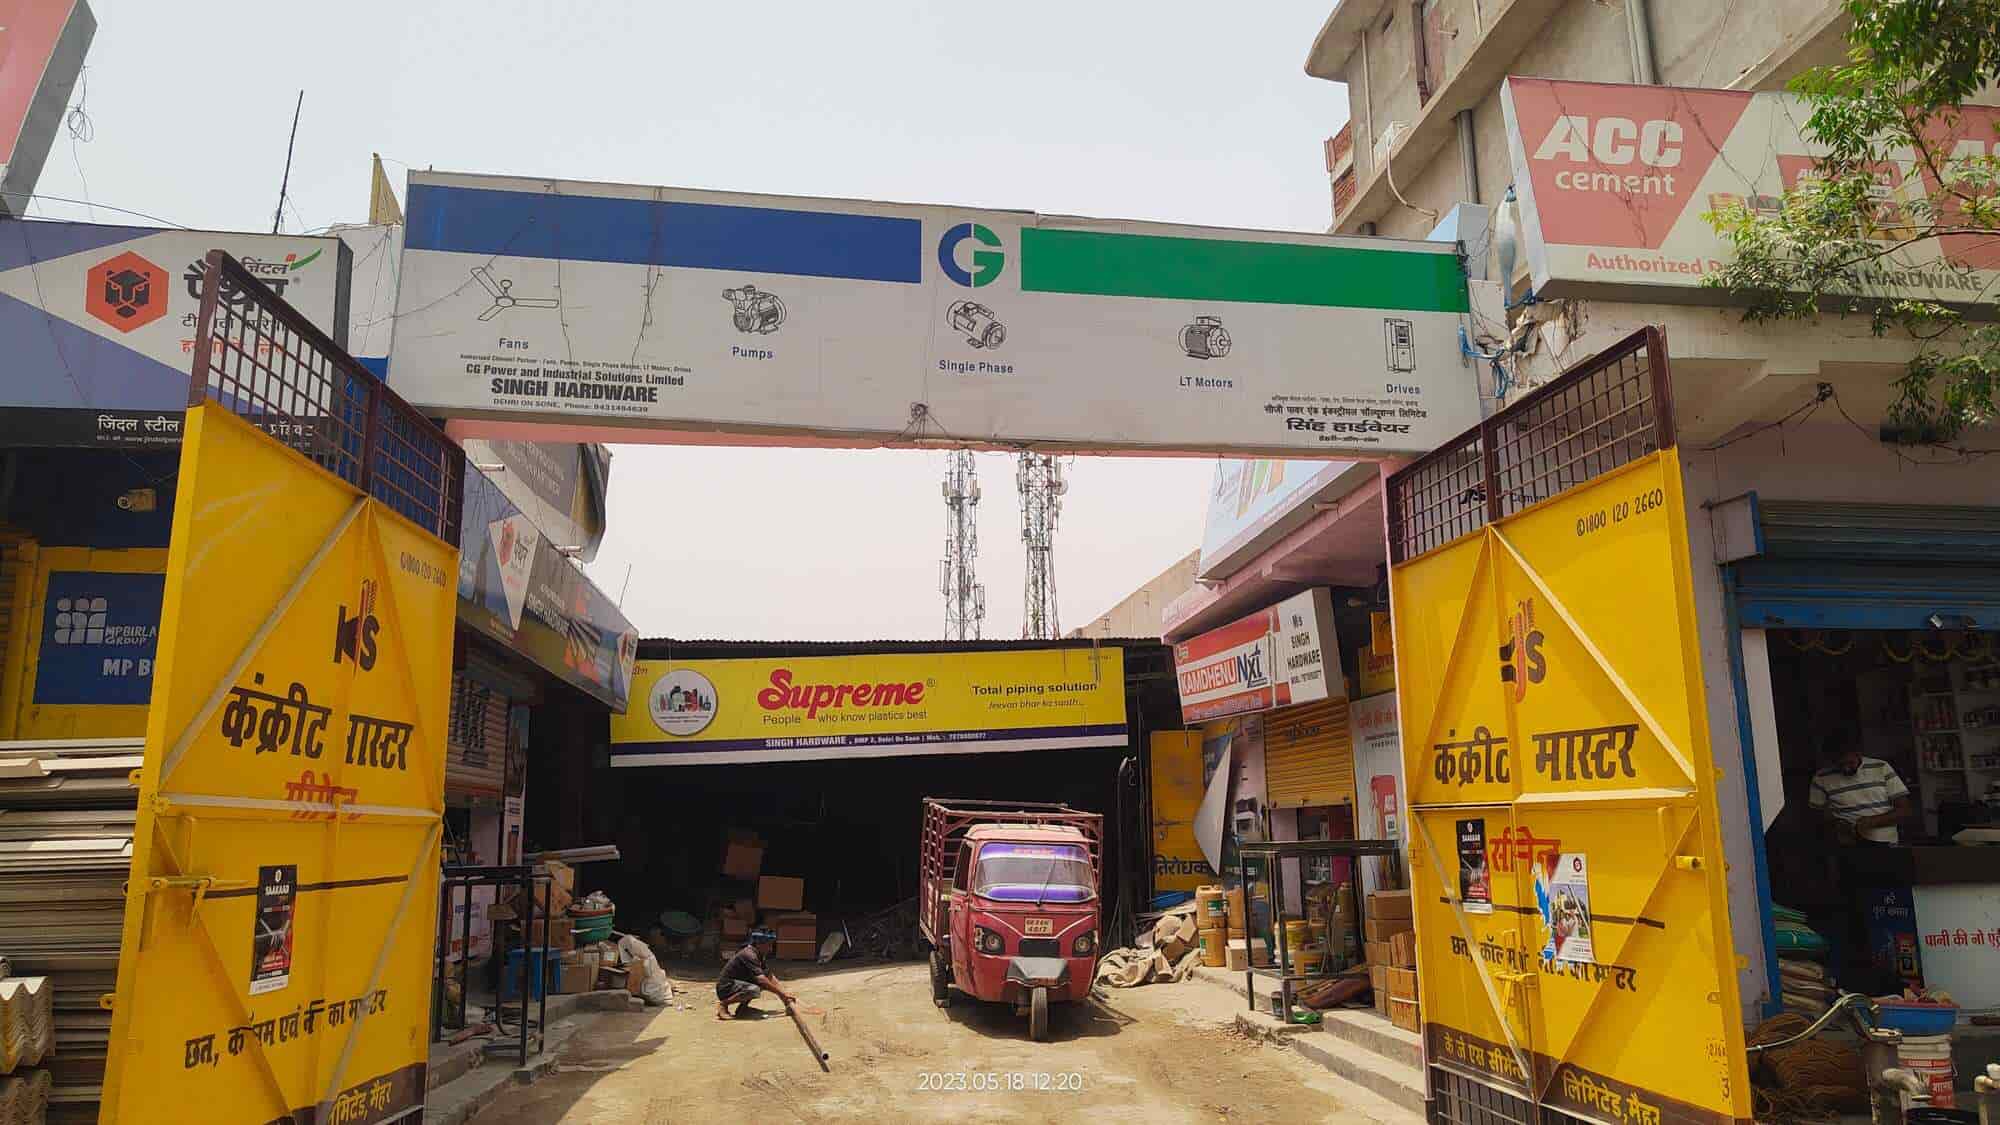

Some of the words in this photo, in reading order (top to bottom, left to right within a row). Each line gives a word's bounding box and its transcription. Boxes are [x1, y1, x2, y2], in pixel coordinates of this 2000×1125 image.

[1533, 115, 1683, 168] ACC
[1555, 168, 1676, 197] cement
[1587, 253, 1702, 276] Authorized
[499, 337, 529, 350] Fans
[732, 346, 774, 361] Pumps
[466, 363, 481, 374] CG
[484, 364, 517, 376] Power
[520, 366, 539, 377] and
[543, 367, 592, 381] Industrial
[595, 370, 643, 384] Solutions
[646, 374, 684, 386] Limited
[938, 359, 975, 376] Single
[978, 360, 1014, 375] Phase
[491, 378, 548, 396] SINGH
[554, 381, 658, 402] HARDWARE
[1178, 375, 1191, 388] LT
[1194, 376, 1234, 390] Motors
[1386, 383, 1421, 395] Drives
[97, 414, 140, 432] जिंदल
[144, 416, 180, 432] स्टील
[1286, 417, 1326, 432] सिंह
[1613, 502, 1629, 523] 120
[1635, 487, 1664, 516] 2660
[103, 658, 134, 677] MP
[1287, 649, 1321, 672] HARDWARE
[1181, 658, 1236, 695] KAMDHENU
[757, 668, 924, 719] Supreme
[972, 685, 1002, 696] Total
[1006, 683, 1044, 697] piping
[1047, 682, 1097, 693] solution
[221, 672, 332, 759] कंक्रीट
[763, 714, 801, 726] People
[818, 712, 838, 724] who
[841, 711, 866, 723] know
[868, 710, 904, 723] plastics
[907, 709, 927, 720] best
[766, 738, 794, 748] SINGH
[798, 736, 847, 747] HARDWARE
[1532, 723, 1639, 781] मास्टर
[1925, 929, 1950, 947] पानी
[1952, 929, 1968, 946] की
[1970, 929, 1985, 945] नो
[328, 1002, 345, 1026] का
